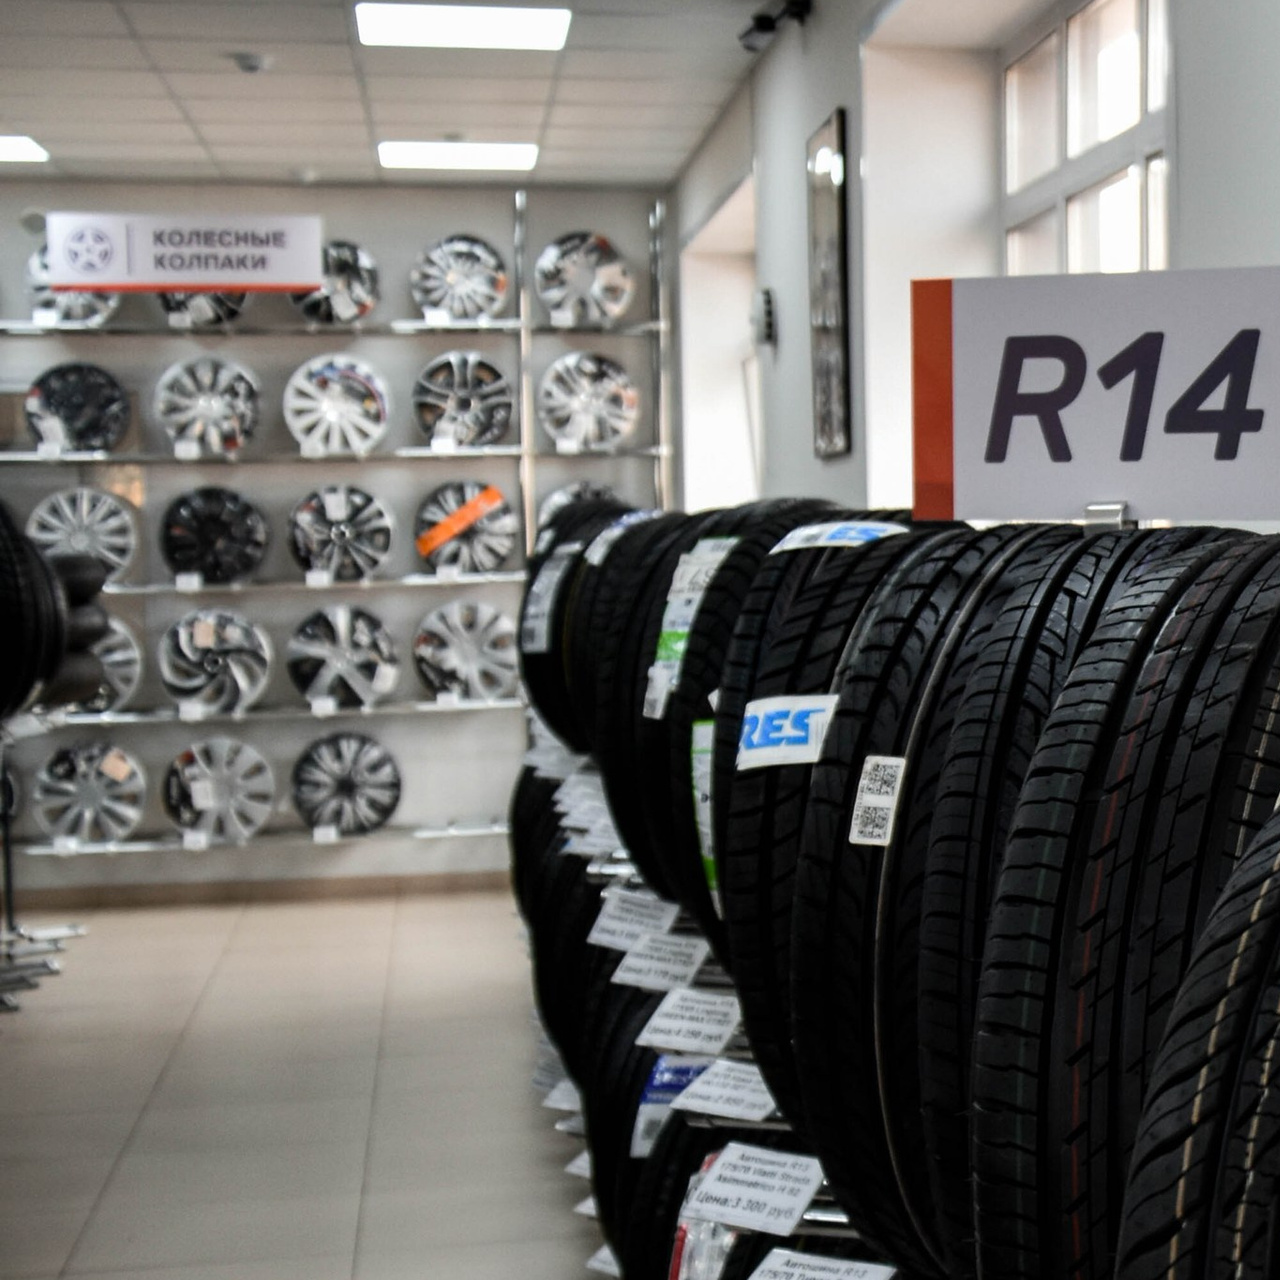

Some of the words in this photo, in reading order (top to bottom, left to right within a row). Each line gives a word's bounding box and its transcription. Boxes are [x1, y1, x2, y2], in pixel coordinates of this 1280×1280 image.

[153, 230, 286, 248] КОЛЕСНЫЕ
[154, 254, 268, 270] КОЛПАКИ
[984, 328, 1265, 463] R14
[782, 1259, 841, 1274] Автошина
[843, 1268, 869, 1278] R13
